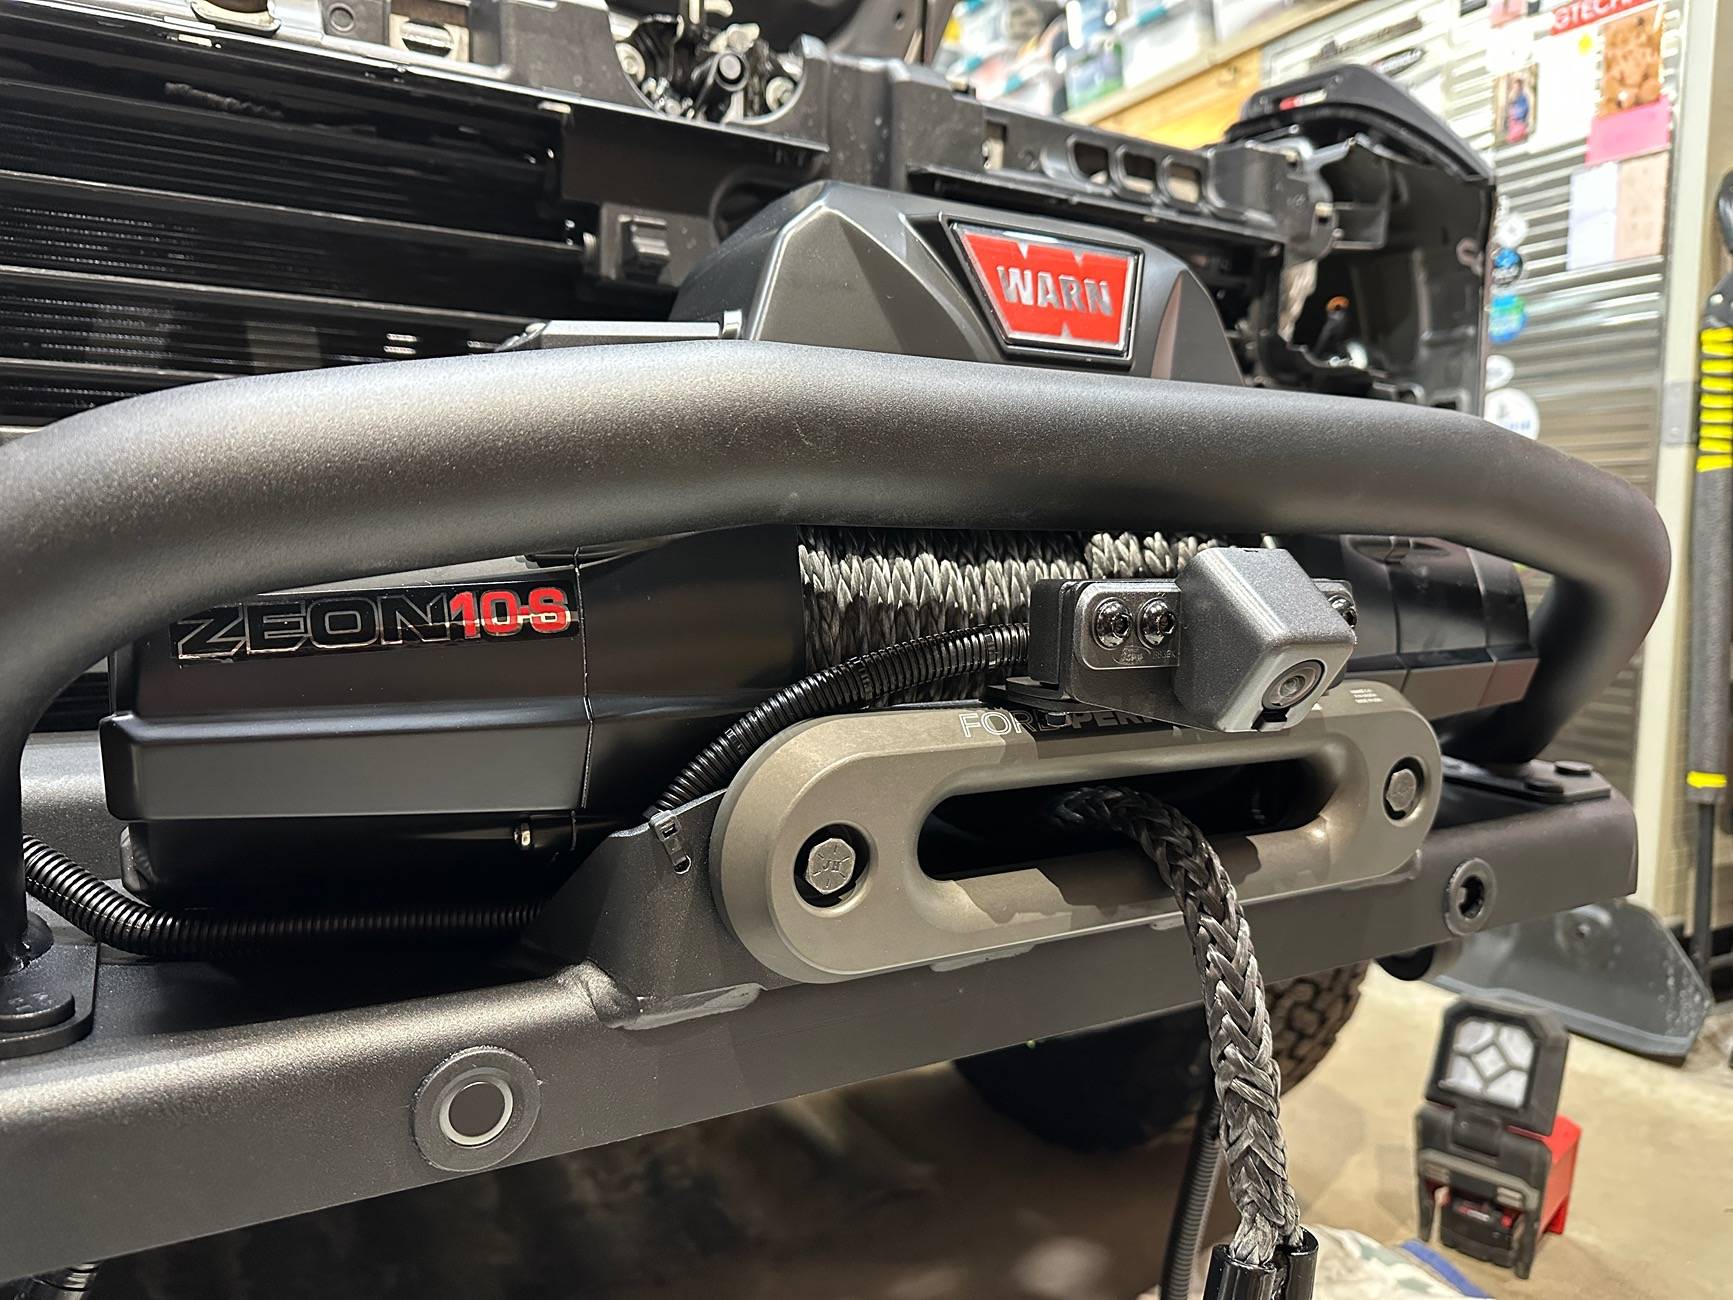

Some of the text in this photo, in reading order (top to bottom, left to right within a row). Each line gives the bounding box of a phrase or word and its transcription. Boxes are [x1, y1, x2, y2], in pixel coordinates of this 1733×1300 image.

[996, 265, 1113, 317] WARN
[177, 587, 570, 660] ZEON 10-S
